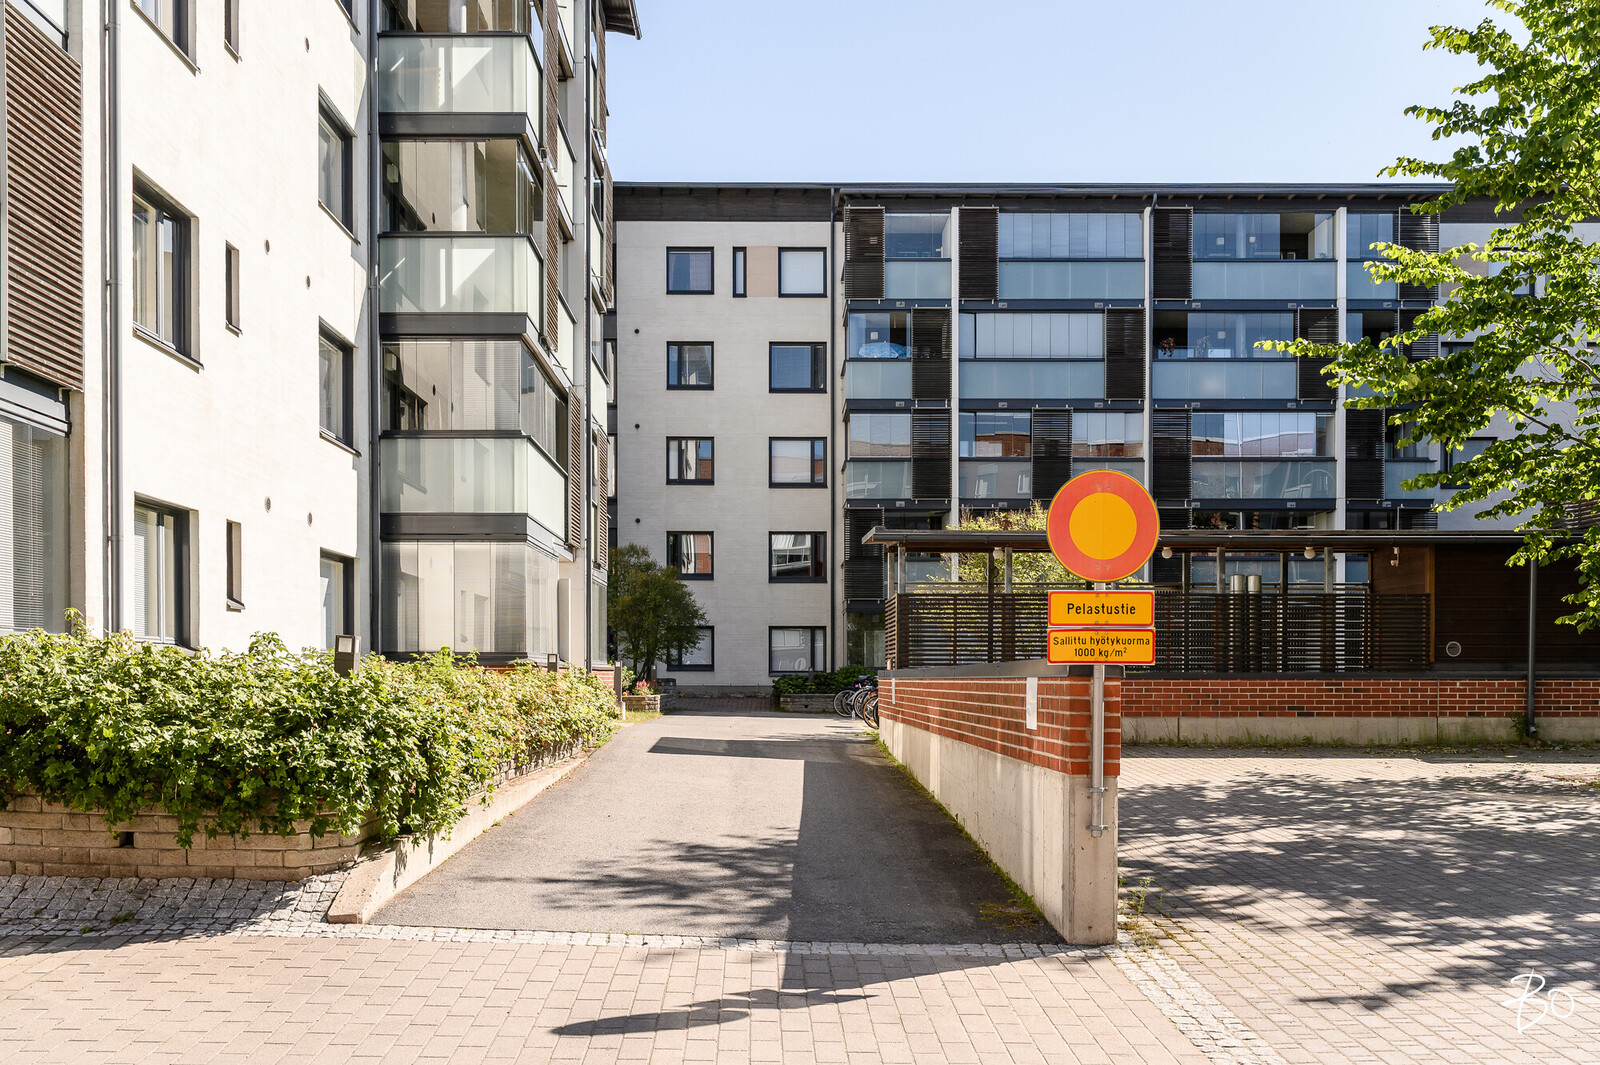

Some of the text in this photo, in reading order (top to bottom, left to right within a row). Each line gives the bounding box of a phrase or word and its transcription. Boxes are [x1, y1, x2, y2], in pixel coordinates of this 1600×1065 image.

[1067, 603, 1136, 615] Pelastustie
[1053, 636, 1150, 647] Sallittu hyötykuorma
[1074, 648, 1095, 657] 1000
